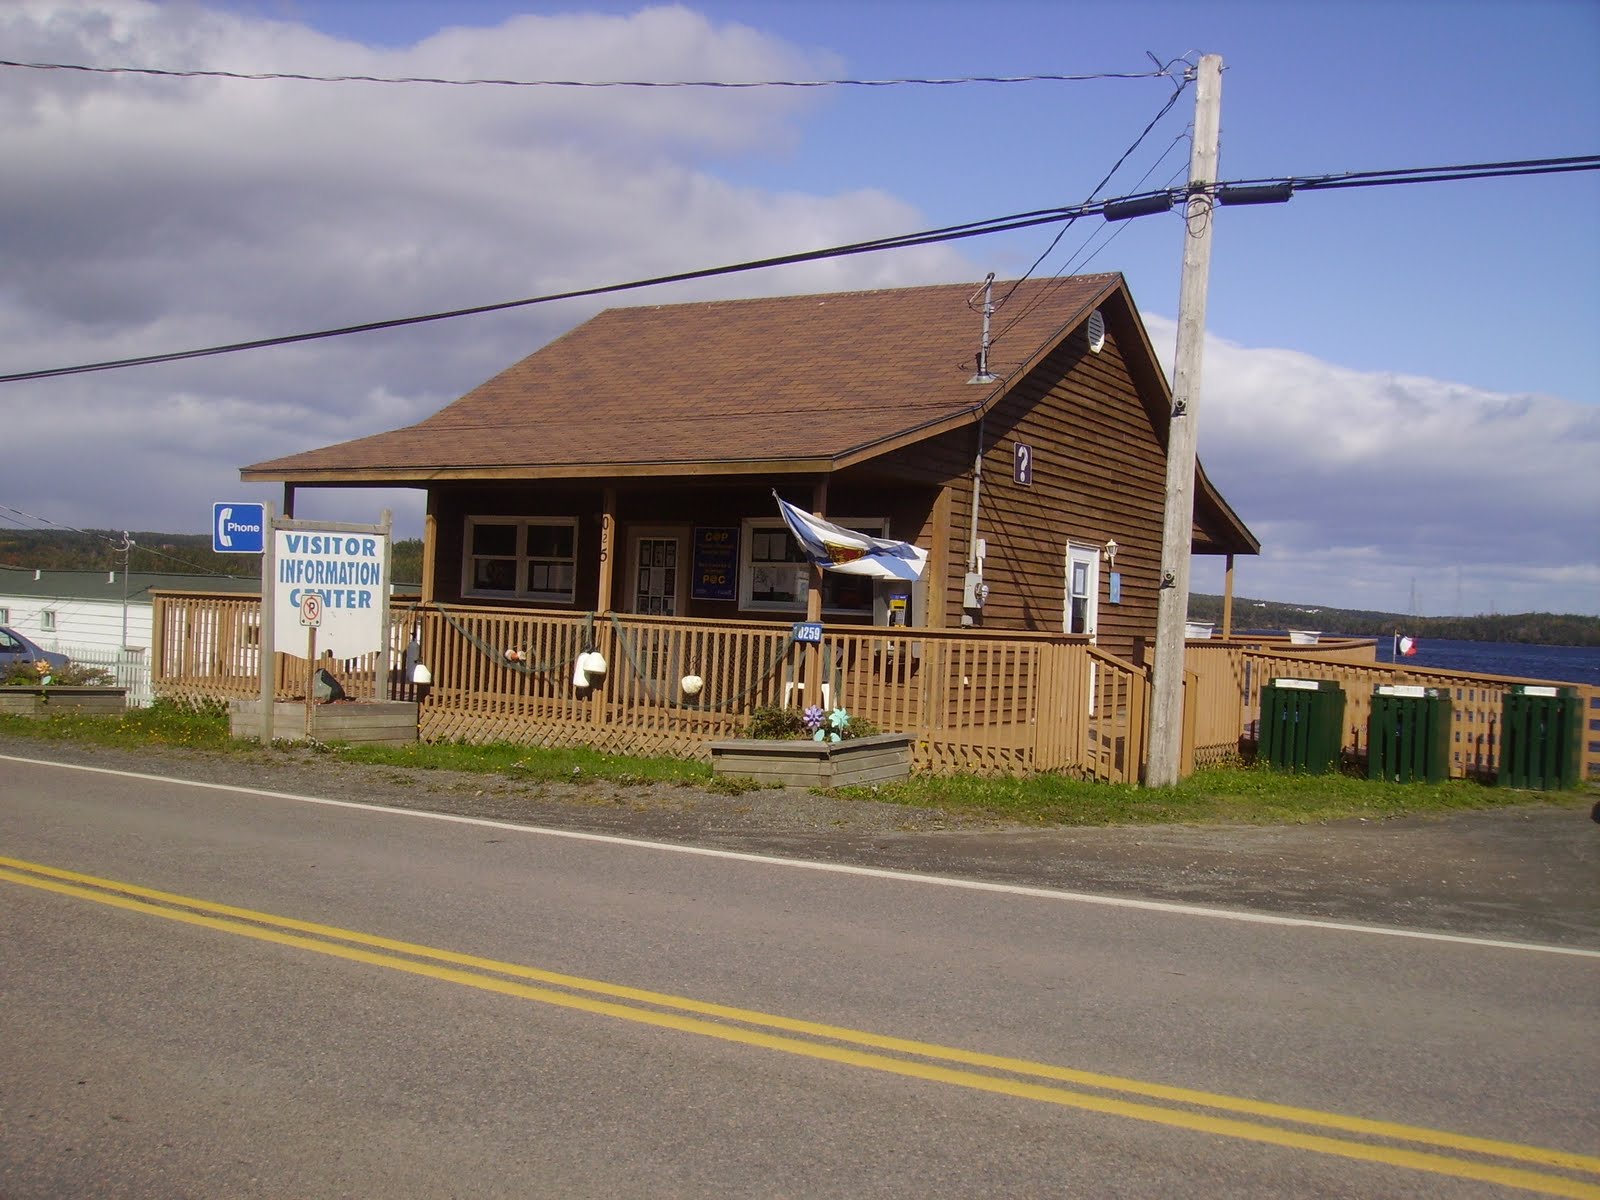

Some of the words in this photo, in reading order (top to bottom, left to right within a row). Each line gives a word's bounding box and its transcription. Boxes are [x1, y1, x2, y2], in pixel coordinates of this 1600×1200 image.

[227, 522, 260, 533] Phone
[285, 534, 376, 557] VISITOR
[279, 559, 380, 586] INFORMATION
[289, 588, 372, 609] CNTER
